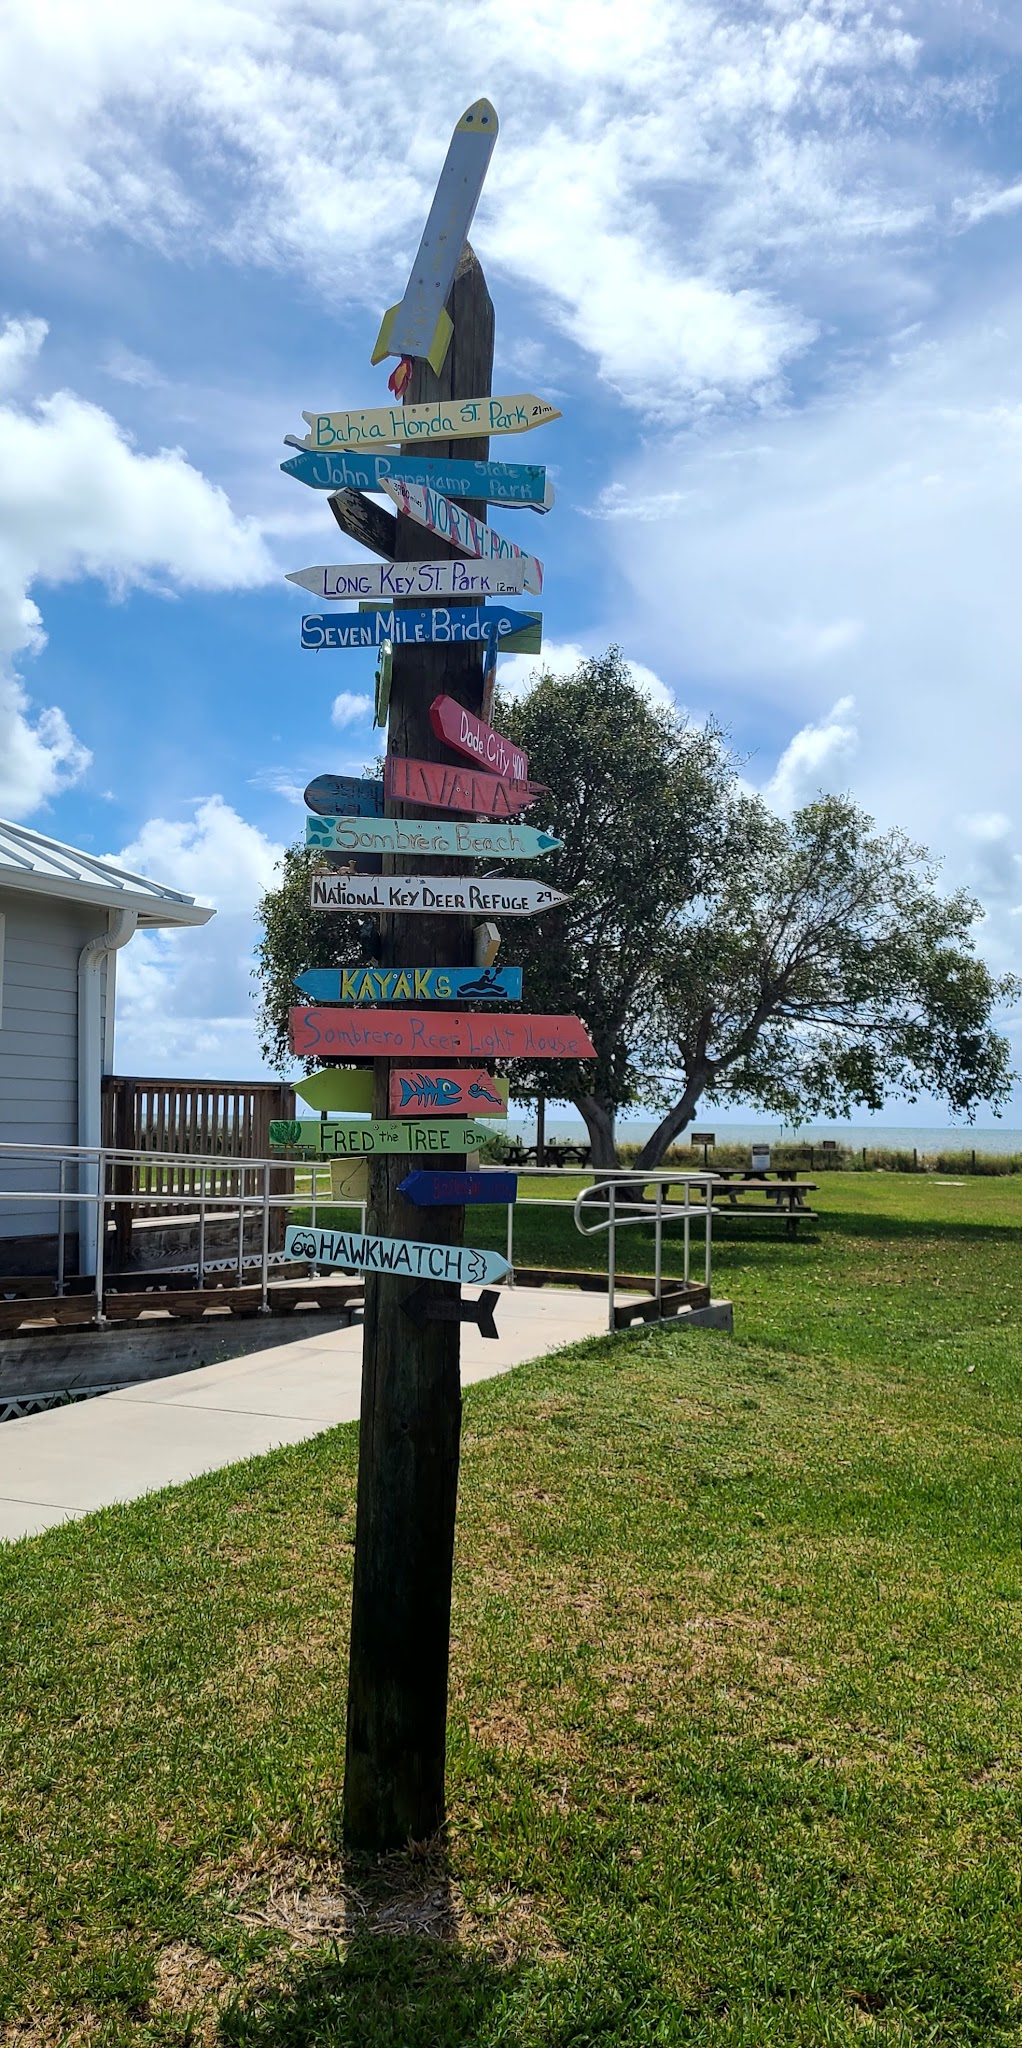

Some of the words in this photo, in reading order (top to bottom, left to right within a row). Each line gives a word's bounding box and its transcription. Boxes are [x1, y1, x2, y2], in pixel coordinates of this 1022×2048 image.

[317, 414, 386, 446] Bahia
[390, 403, 458, 438] Honda
[489, 401, 529, 430] Park
[313, 454, 369, 486] John
[375, 457, 470, 496] Pnnekamp
[474, 461, 520, 479] State
[489, 479, 533, 499] Park
[425, 487, 483, 557] NORTH
[324, 569, 372, 595] LONG
[380, 564, 415, 594] KEY
[452, 562, 491, 591] Park
[301, 614, 372, 647] SEVEN
[460, 711, 484, 754] Dade
[487, 733, 510, 776] City
[335, 819, 450, 851] Sombrero
[455, 824, 526, 852] Beach
[389, 886, 420, 906] KEY
[423, 887, 466, 908] DEER
[469, 885, 530, 910] REFUGE
[303, 1012, 403, 1049] Sombrero
[467, 1023, 515, 1056] Light
[523, 1024, 579, 1055] House
[320, 1123, 375, 1151] FRED
[379, 1130, 399, 1142] the
[401, 1122, 450, 1151] TREE
[319, 1233, 463, 1280] HAWKWATCH
